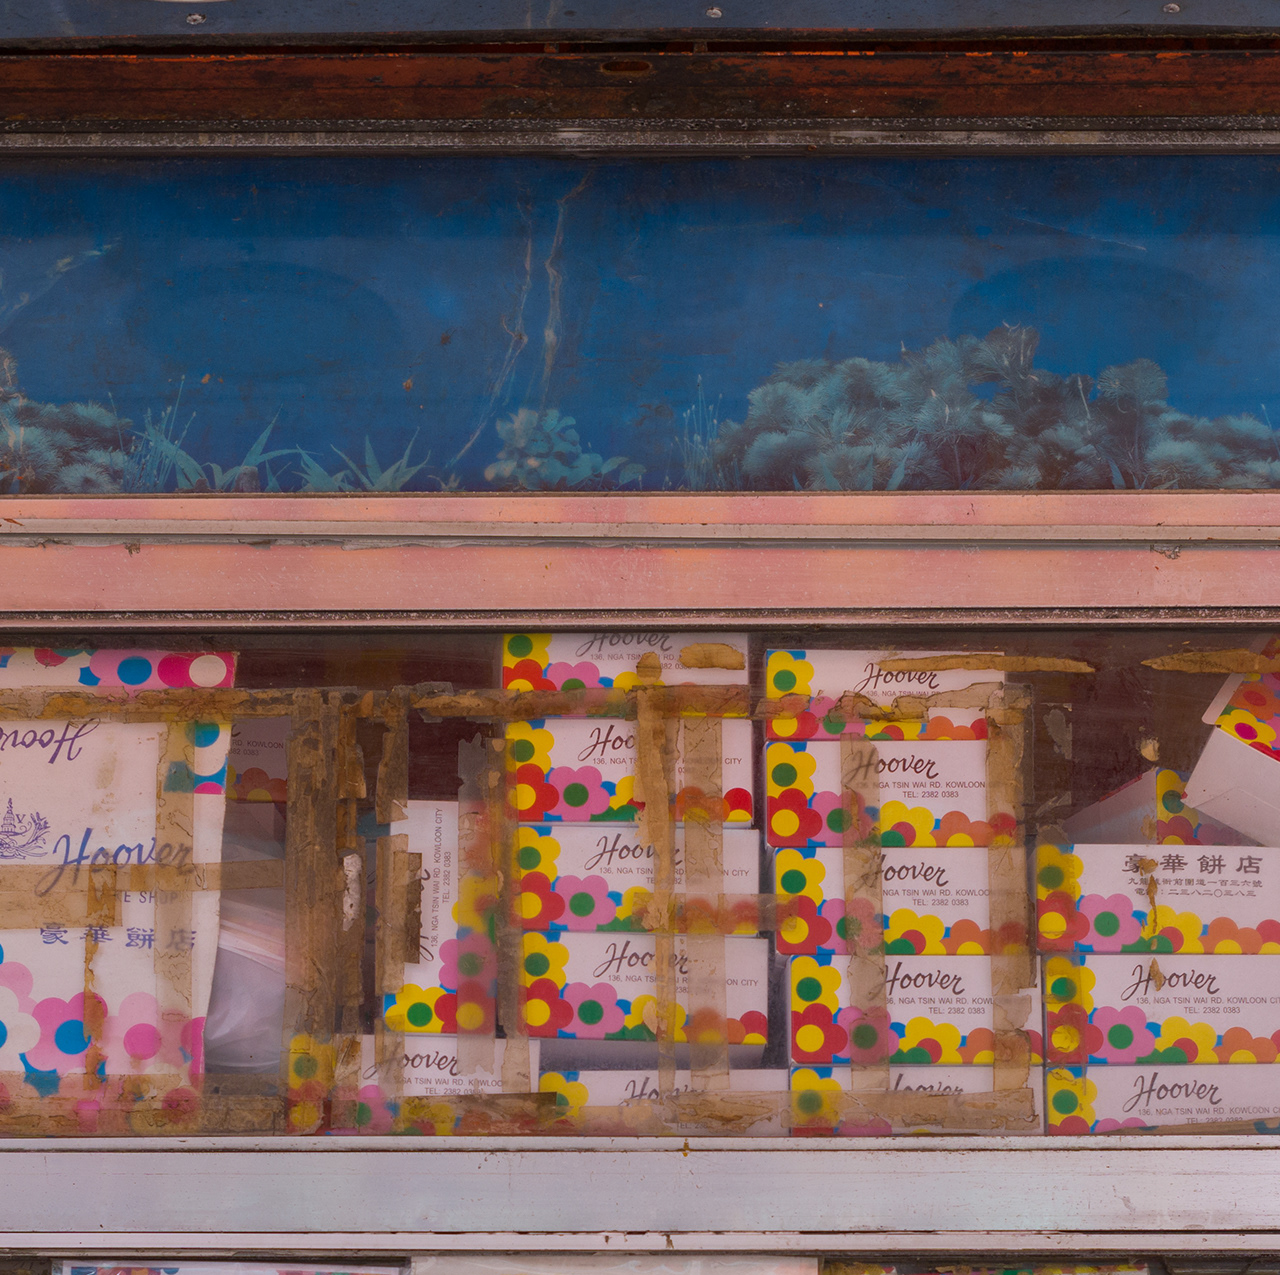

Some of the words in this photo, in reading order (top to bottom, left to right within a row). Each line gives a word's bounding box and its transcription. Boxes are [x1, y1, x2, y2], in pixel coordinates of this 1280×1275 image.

[578, 724, 635, 761] Hoo
[945, 781, 985, 789] KOWLOON
[34, 827, 196, 897] Hoover
[40, 922, 197, 949] 豪華餅店
[1203, 1006, 1220, 1014] 2382
[1223, 1006, 1241, 1014] 0383
[1122, 1072, 1222, 1113] Hoover
[1228, 1107, 1271, 1115] KOWLOON
